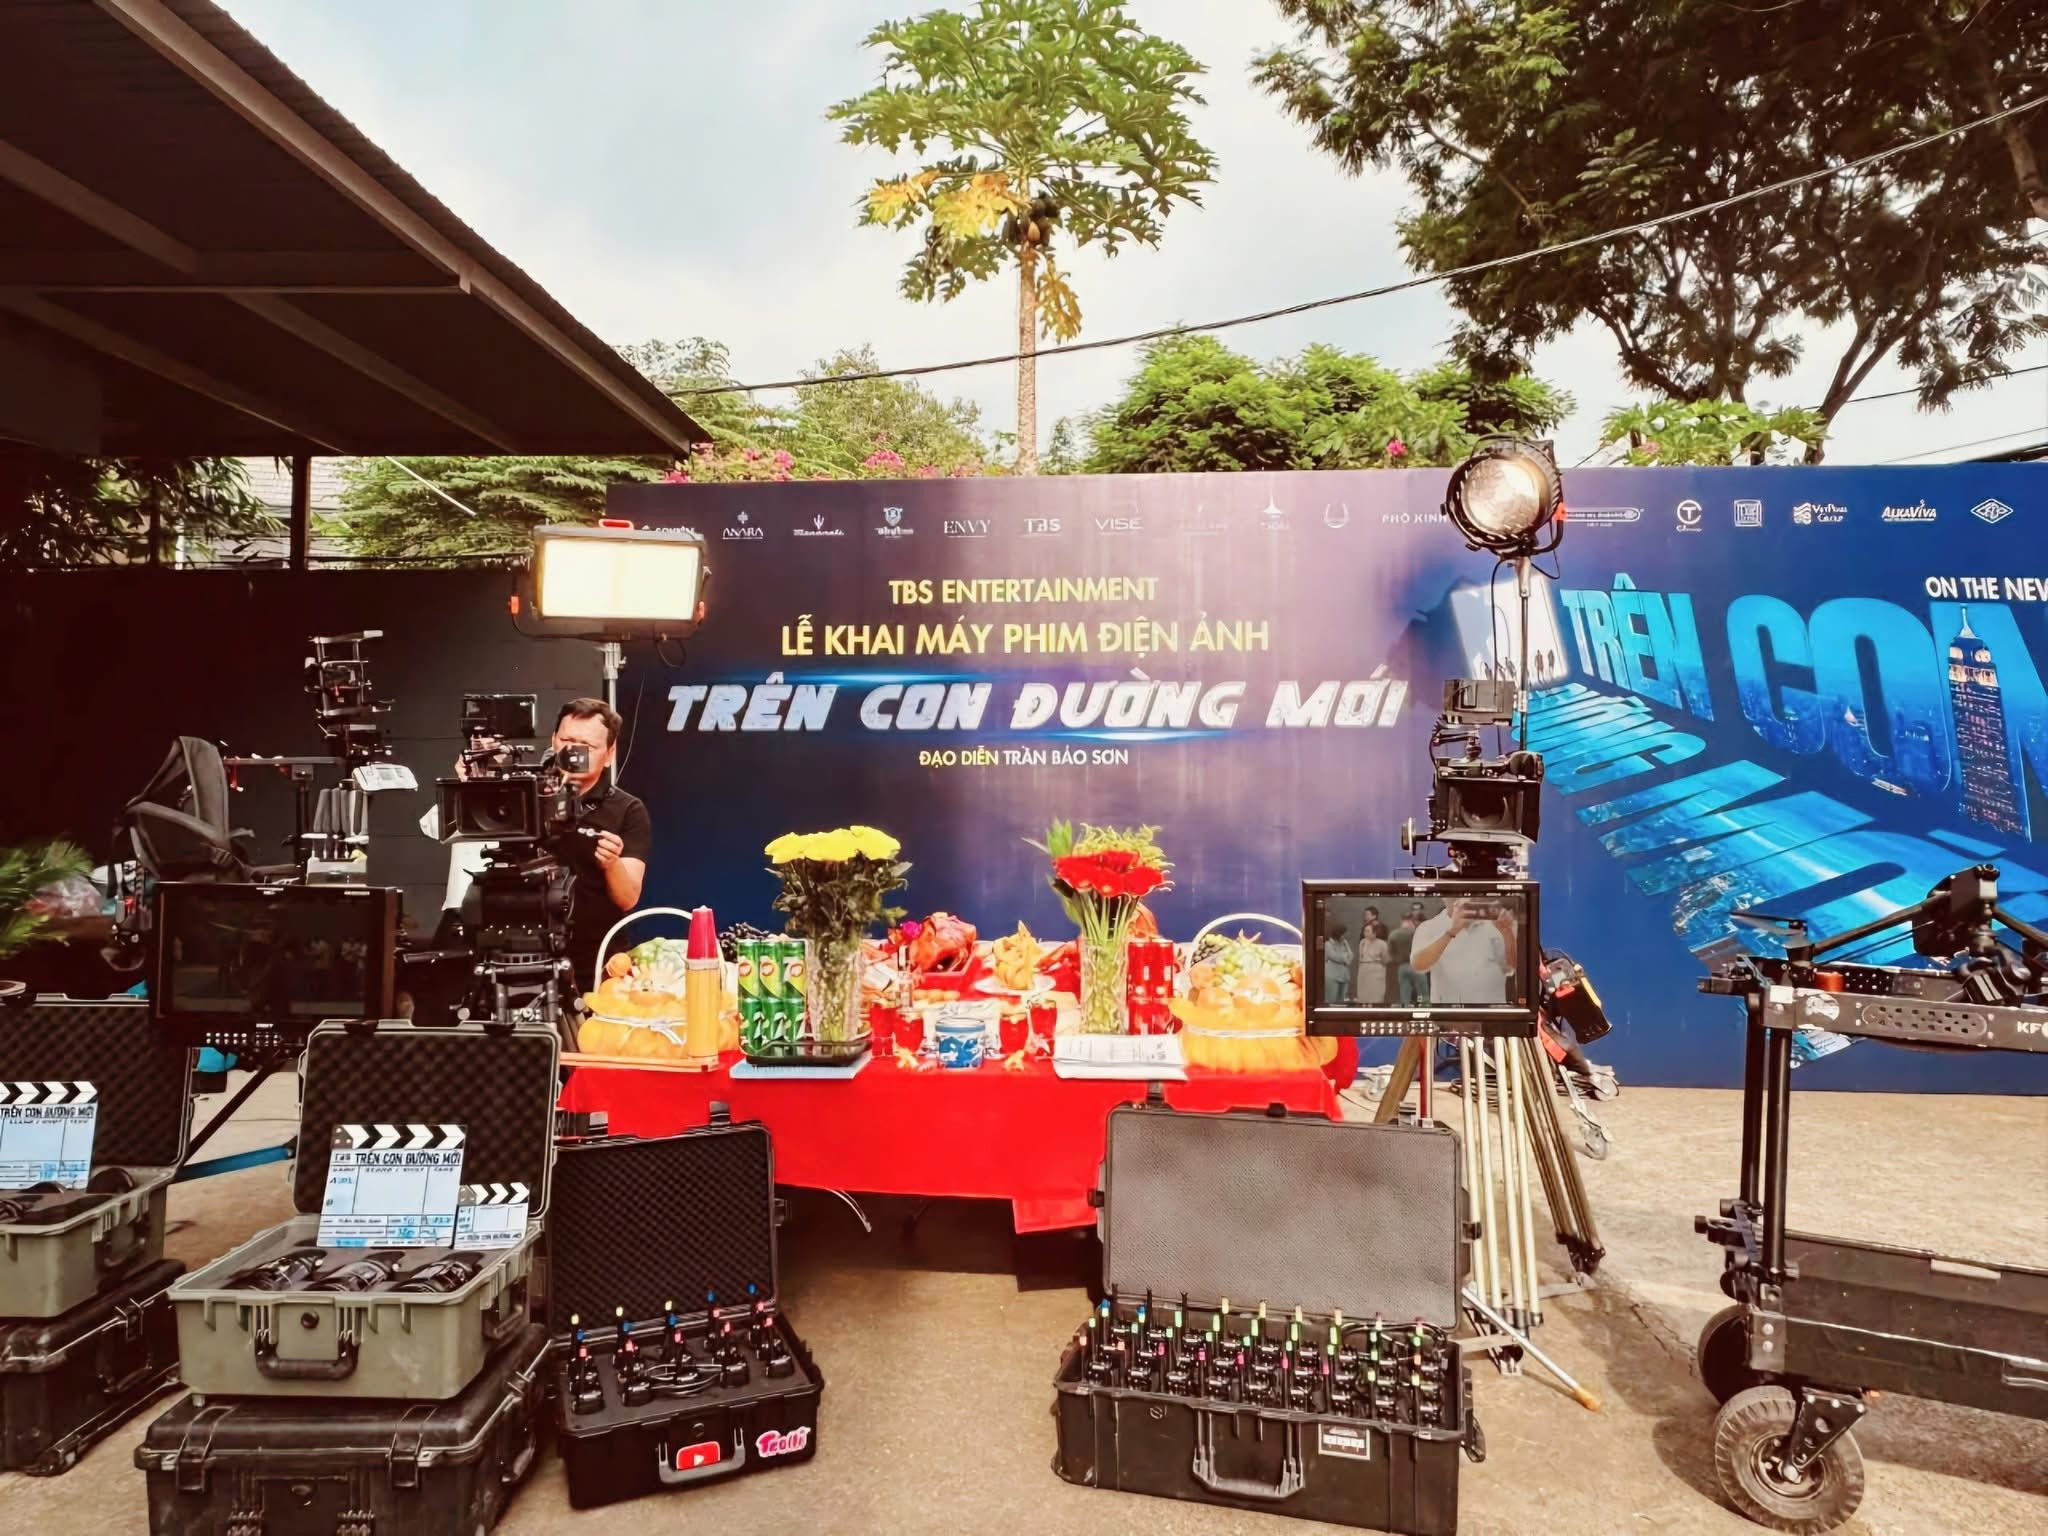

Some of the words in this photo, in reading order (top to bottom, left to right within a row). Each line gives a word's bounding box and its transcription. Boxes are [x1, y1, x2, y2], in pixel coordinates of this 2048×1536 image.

[943, 519, 991, 534] ENVY
[1095, 517, 1143, 530] VISE
[889, 579, 933, 604] TBS
[942, 577, 1159, 604] ENTERTAINMENT
[1925, 576, 1958, 599] ON
[1960, 577, 2000, 600] THE
[781, 613, 814, 656] LỄ
[825, 625, 904, 655] KHAI
[916, 615, 993, 654] MÁY
[1004, 624, 1089, 653] PHIM
[1097, 616, 1178, 659] ĐIỆN
[1190, 610, 1269, 651] ẢNH
[1559, 573, 1715, 722] TRÊN
[666, 671, 839, 732] TRÊN
[859, 683, 993, 731] CON
[1010, 666, 1247, 729] ĐƯỜNG
[1265, 664, 1409, 729] MỚI
[918, 750, 957, 769] ĐẠO
[961, 745, 999, 766] DIỄN
[1091, 748, 1129, 766] SƠN
[383, 1152, 402, 1164] CON
[757, 1427, 810, 1457] Trolli
